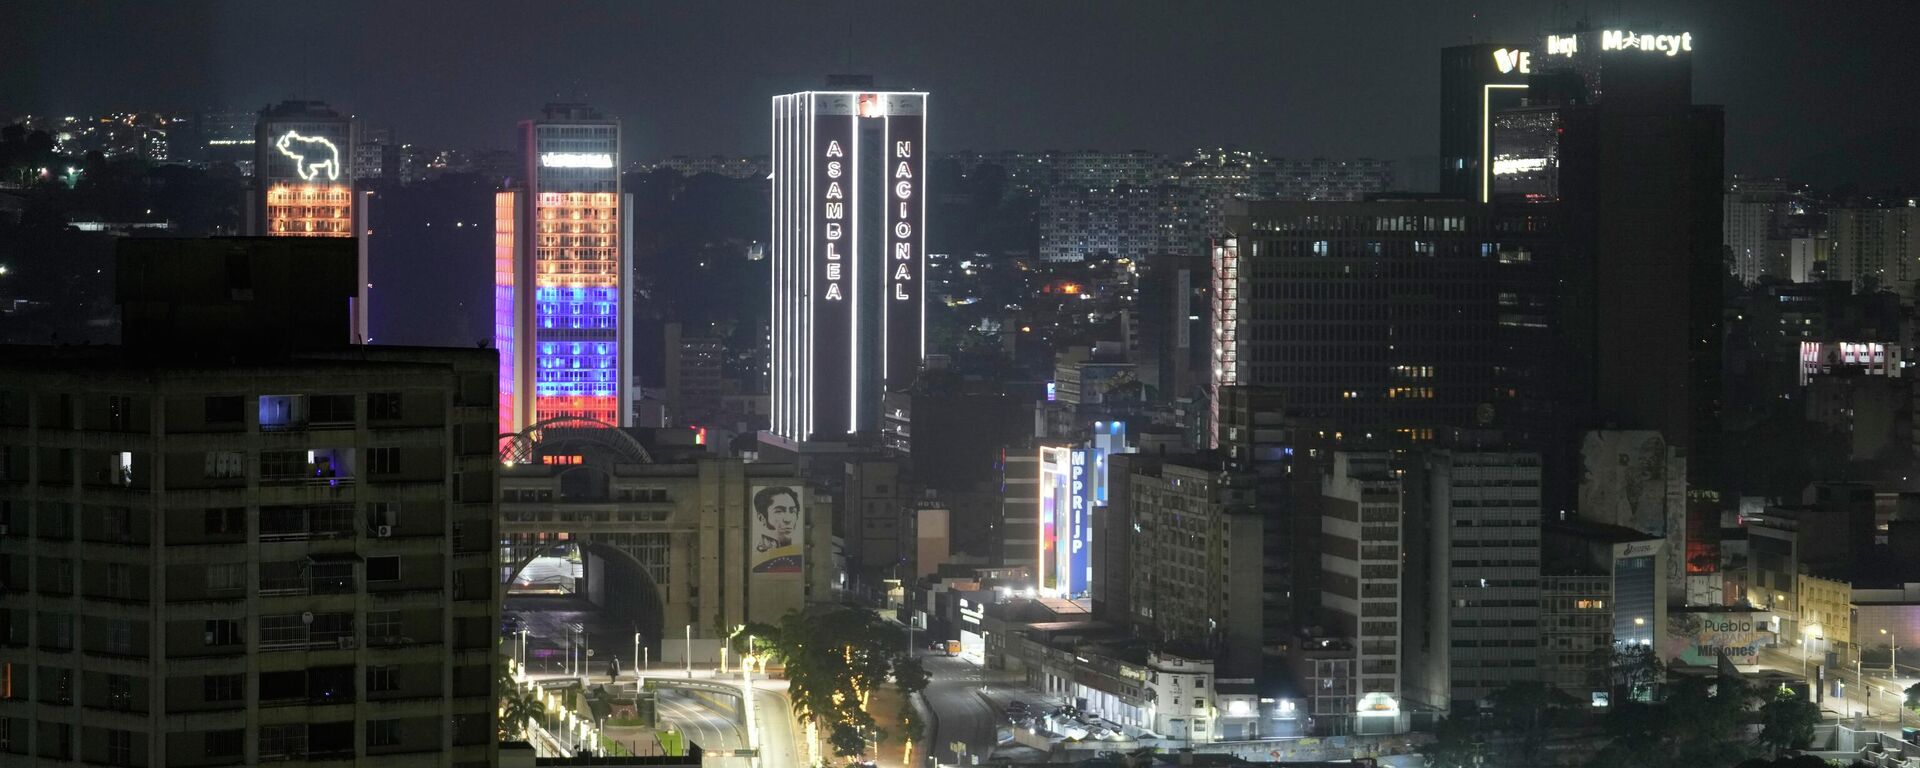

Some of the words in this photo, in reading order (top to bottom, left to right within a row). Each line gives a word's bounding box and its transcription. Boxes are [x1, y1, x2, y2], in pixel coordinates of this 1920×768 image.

[825, 140, 843, 300] ASAMBLEA
[895, 141, 912, 300] NACIONAL
[1072, 451, 1085, 554] MPPRIJP
[1697, 645, 1756, 657] Misiones
[1704, 619, 1751, 633] Pueblo
